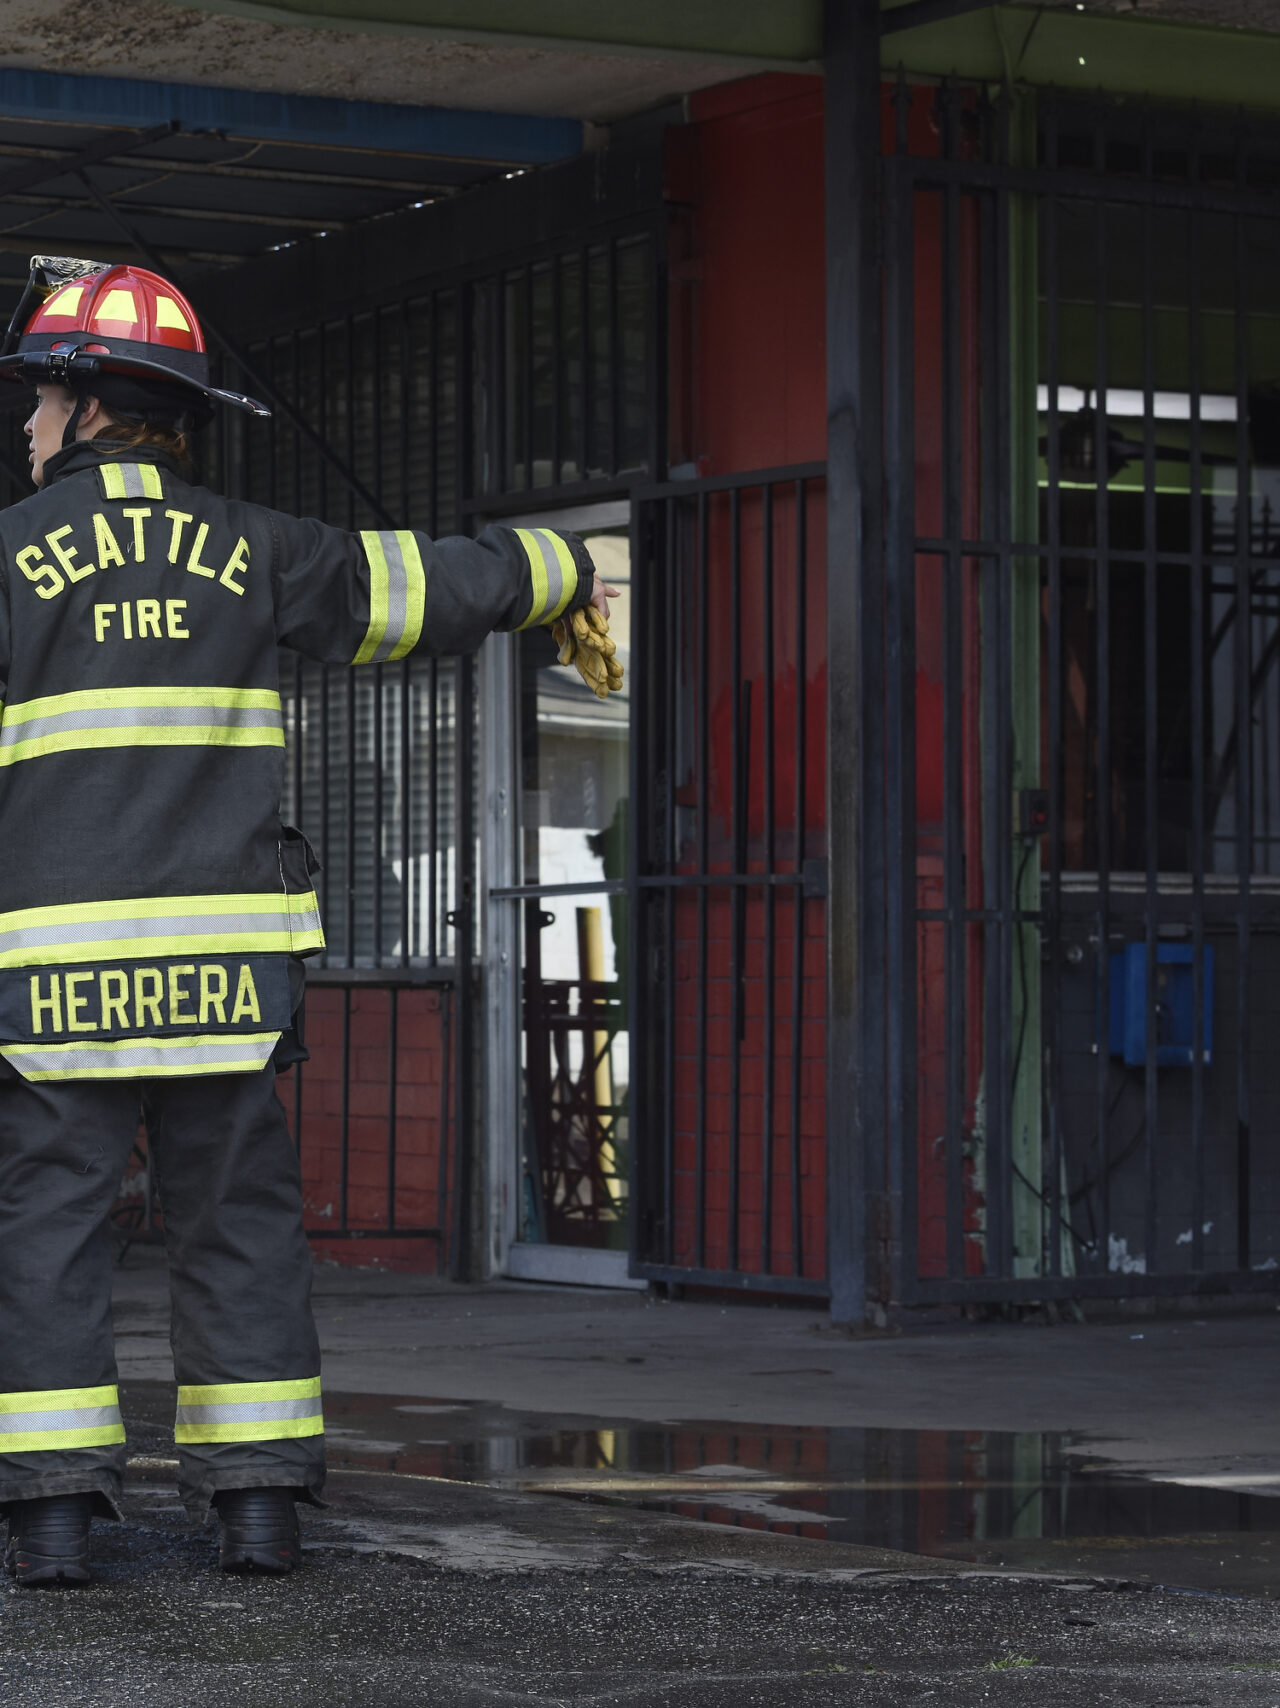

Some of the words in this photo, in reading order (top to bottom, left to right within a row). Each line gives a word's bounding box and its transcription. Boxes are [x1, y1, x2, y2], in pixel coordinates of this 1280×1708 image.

[15, 507, 251, 600] SEATTLE
[94, 599, 190, 643] FIRE
[30, 963, 262, 1034] HERRERA
